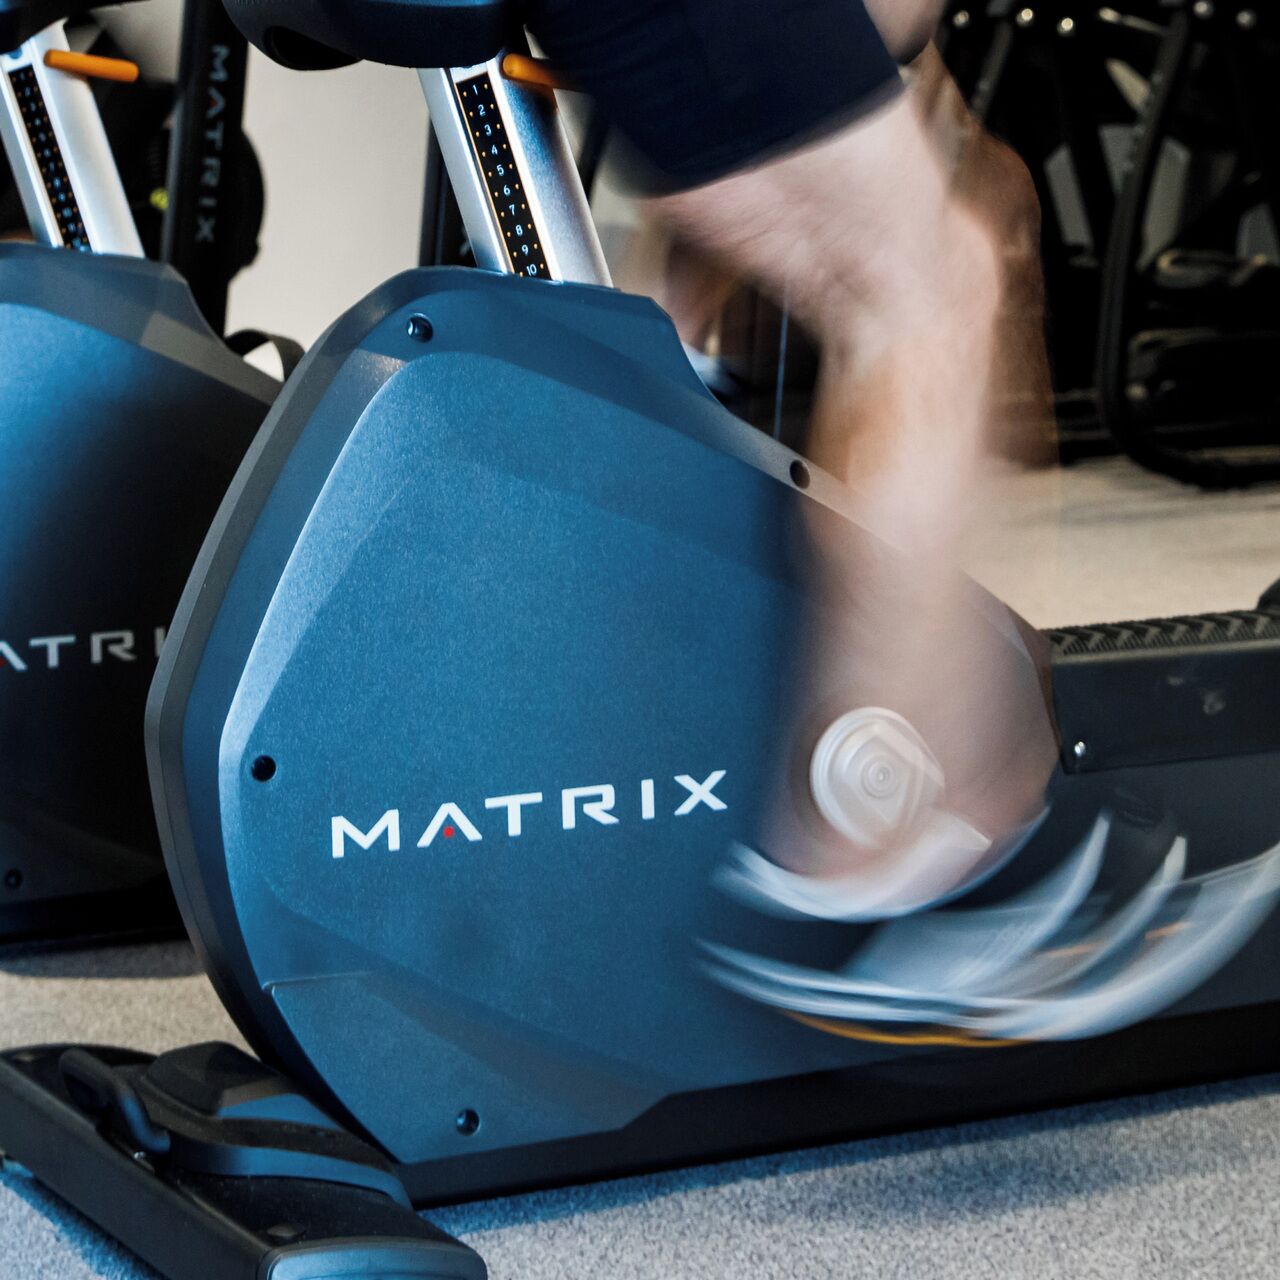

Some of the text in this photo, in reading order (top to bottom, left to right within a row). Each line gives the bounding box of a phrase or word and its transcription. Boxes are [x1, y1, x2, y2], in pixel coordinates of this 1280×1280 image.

[478, 104, 486, 116] 2
[484, 124, 492, 136] 3
[195, 45, 230, 243] MATRIX
[491, 144, 498, 155] 4
[496, 164, 505, 176] 5
[503, 184, 511, 196] 6
[508, 204, 515, 216] 7
[515, 224, 523, 236] 8
[521, 244, 529, 256] 9
[526, 263, 537, 276] 10
[331, 770, 728, 859] MATRIX
